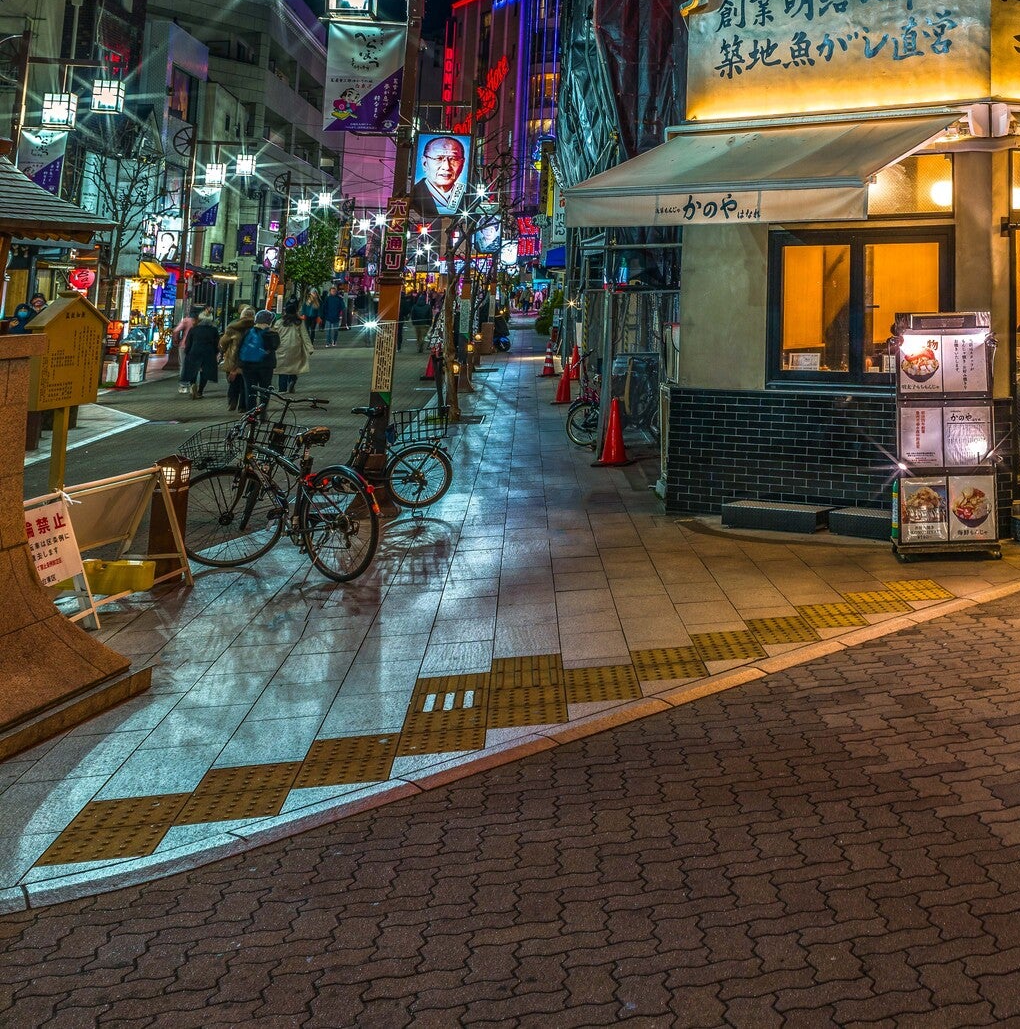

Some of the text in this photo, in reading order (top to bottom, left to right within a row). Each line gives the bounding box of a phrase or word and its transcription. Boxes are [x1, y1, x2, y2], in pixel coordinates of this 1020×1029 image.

[714, 10, 957, 80] 築地魚がし直営
[683, 193, 738, 221] かのや
[737, 209, 761, 219] はなれ
[385, 200, 408, 270] 六区通り
[950, 412, 972, 421] かのや
